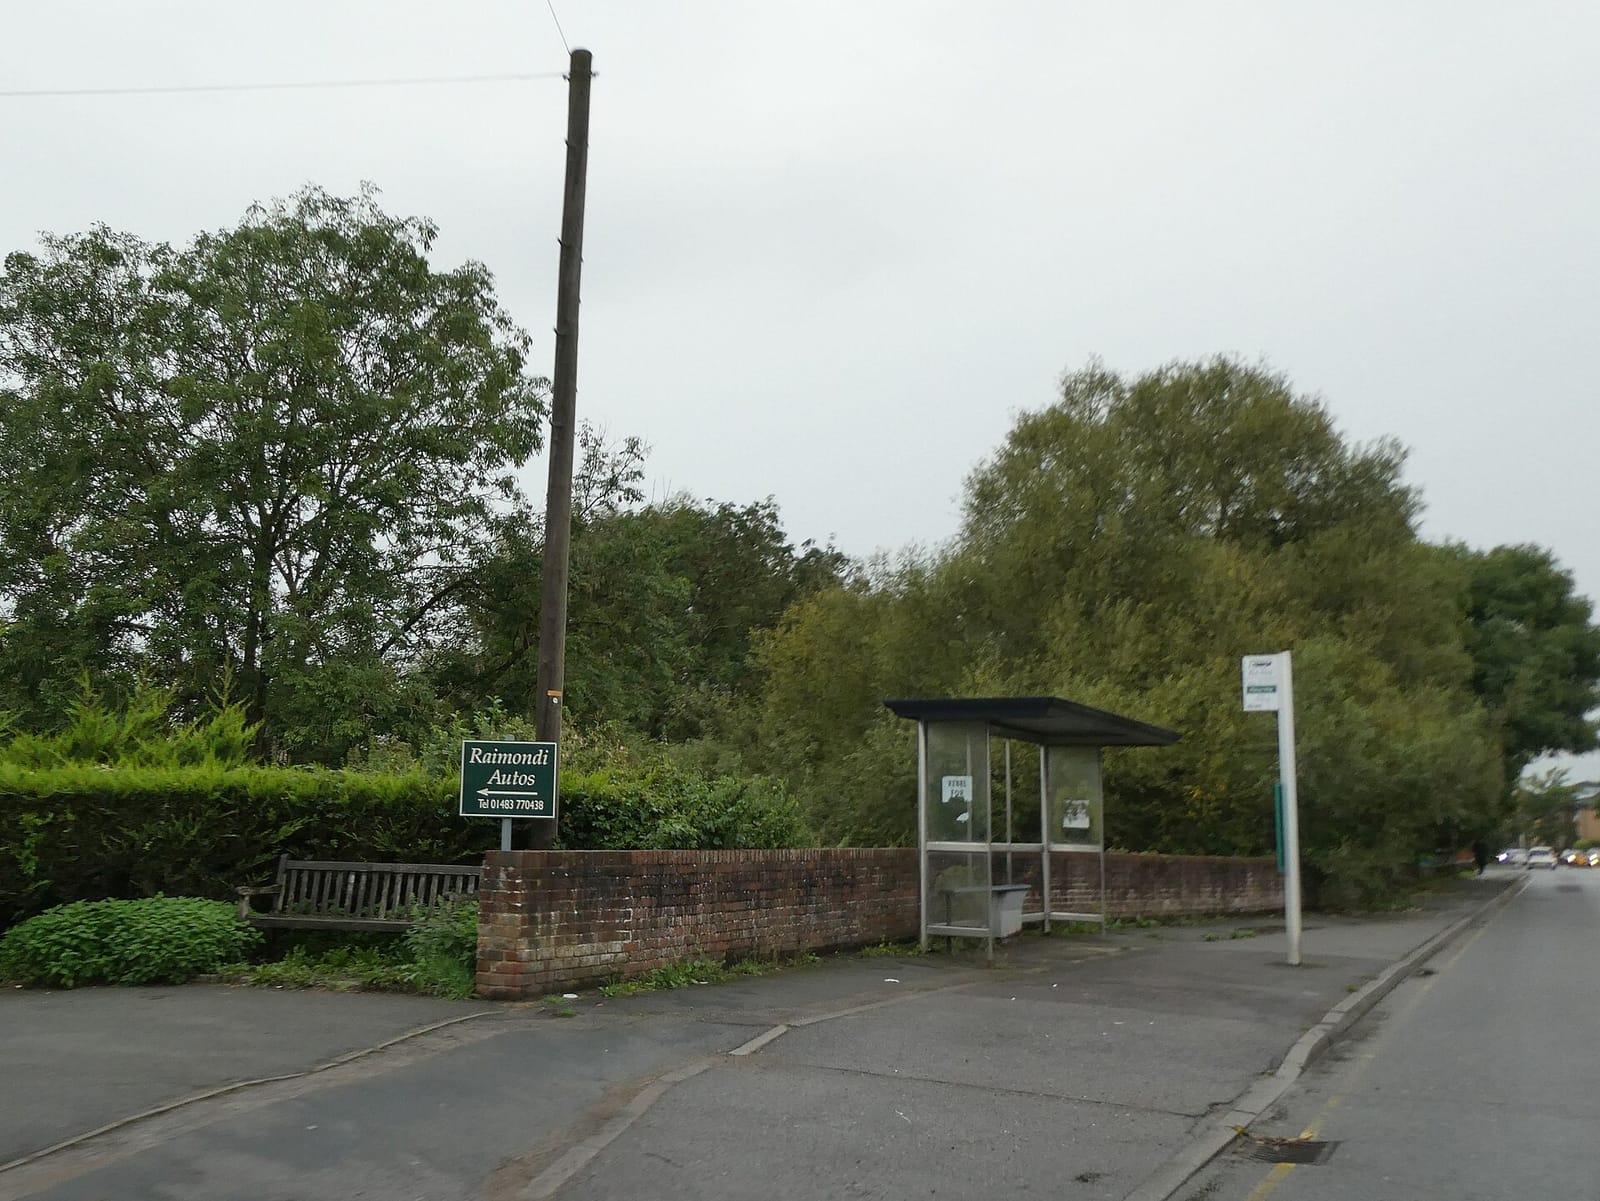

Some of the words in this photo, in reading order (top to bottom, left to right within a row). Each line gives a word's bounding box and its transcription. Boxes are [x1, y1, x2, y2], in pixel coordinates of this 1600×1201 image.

[469, 747, 549, 765] Raimondi
[486, 769, 536, 786] Autos
[478, 798, 489, 809] Tel
[490, 799, 514, 809] 01483
[516, 799, 544, 810] 770438
